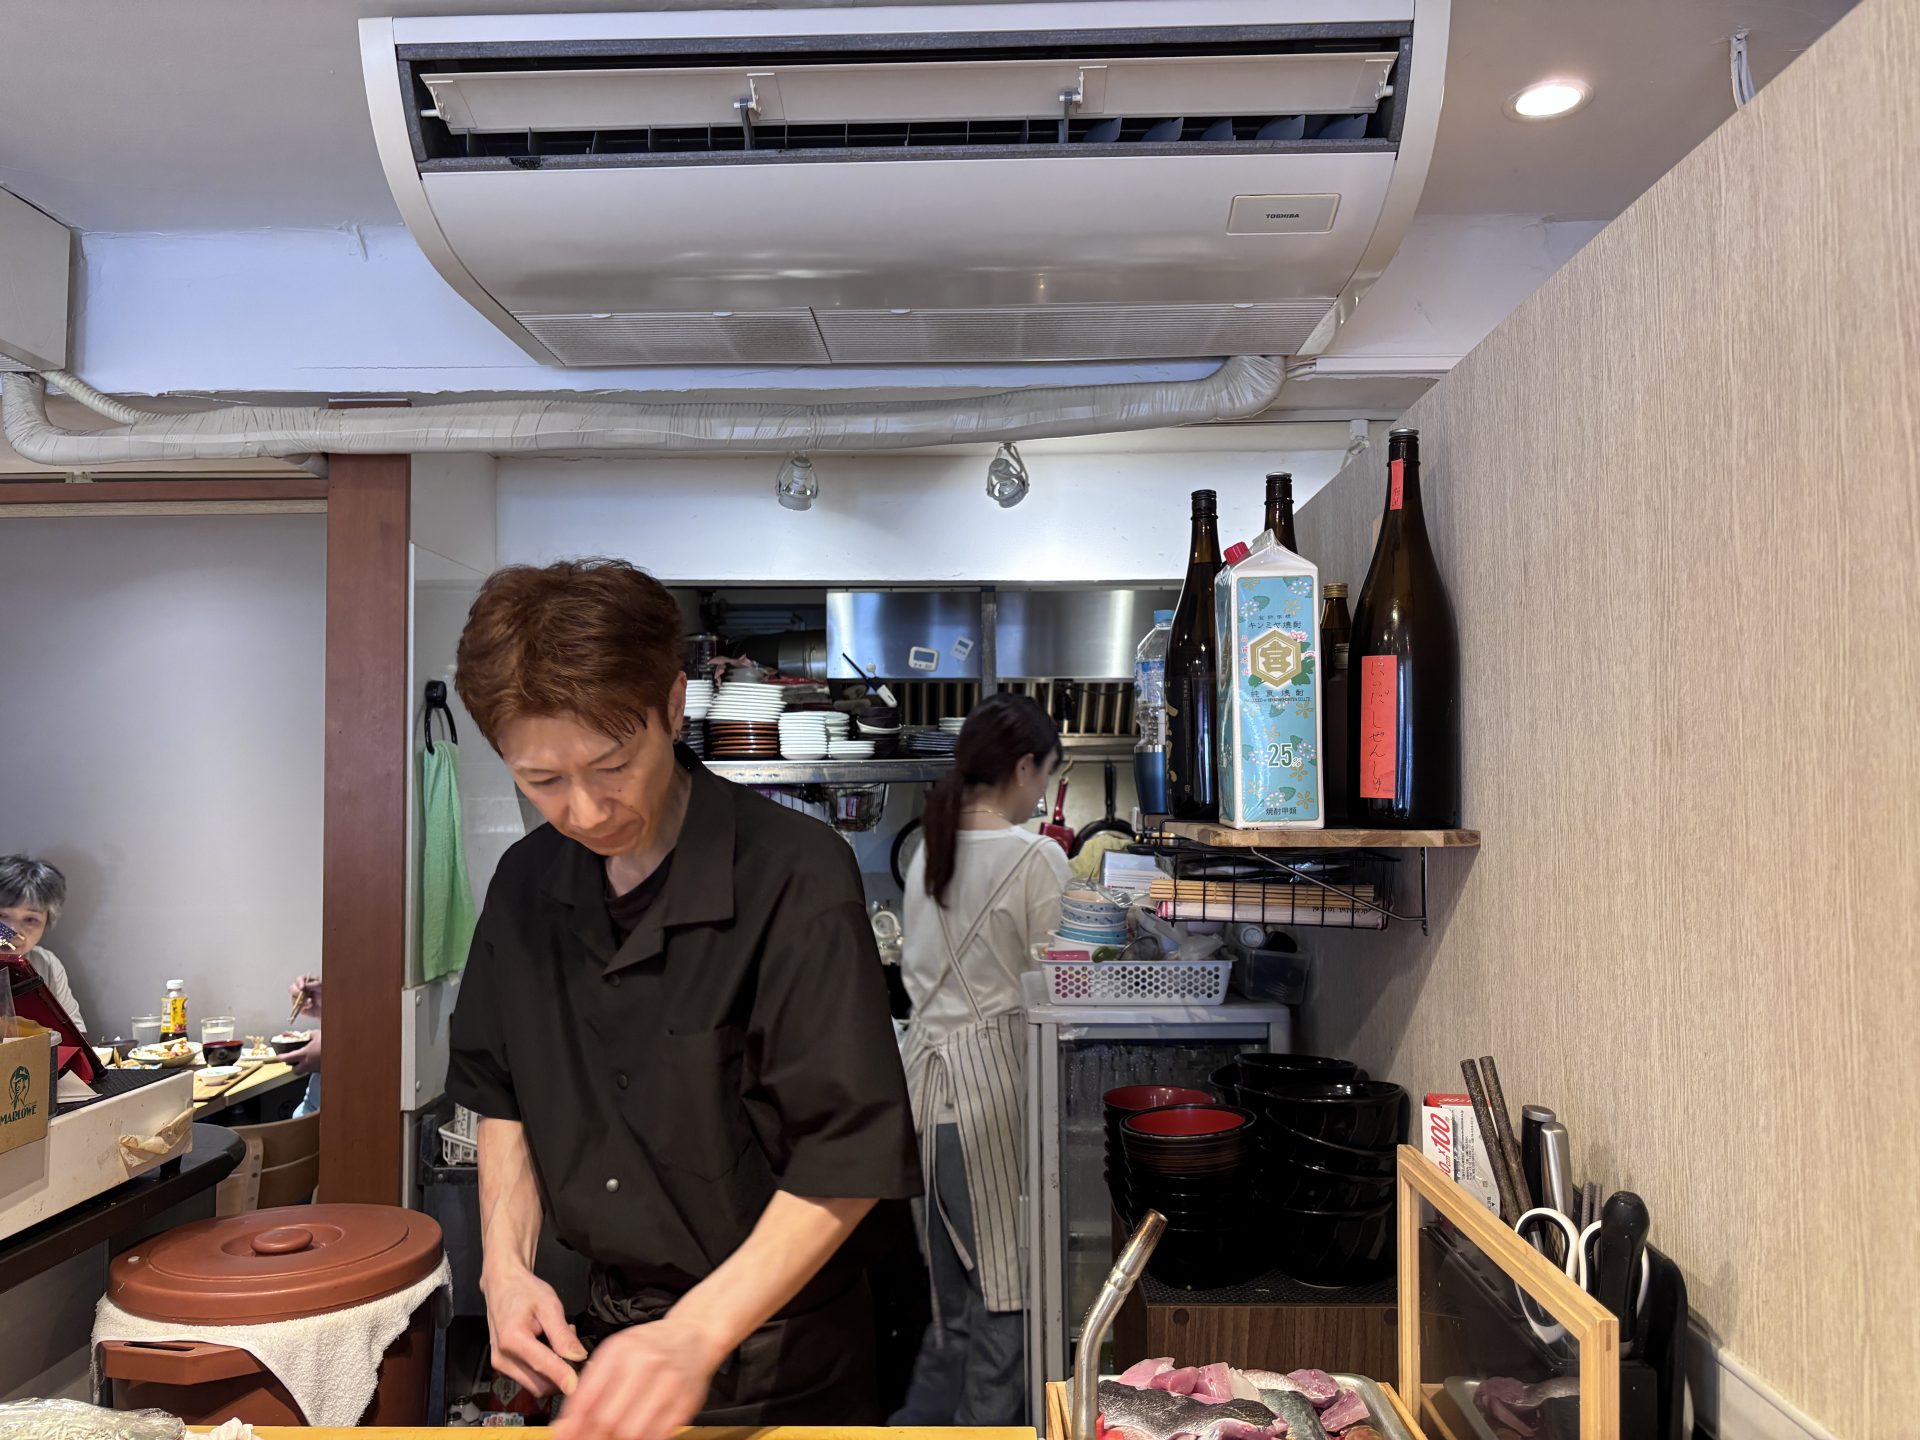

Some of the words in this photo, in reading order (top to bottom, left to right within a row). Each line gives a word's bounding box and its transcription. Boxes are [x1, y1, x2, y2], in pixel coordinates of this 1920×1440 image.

[1248, 621, 1302, 629] キンミヤ焼酎
[1267, 742, 1302, 767] 25%
[1265, 806, 1297, 816] 焼酎甲類
[0, 1104, 37, 1125] MARLOWE
